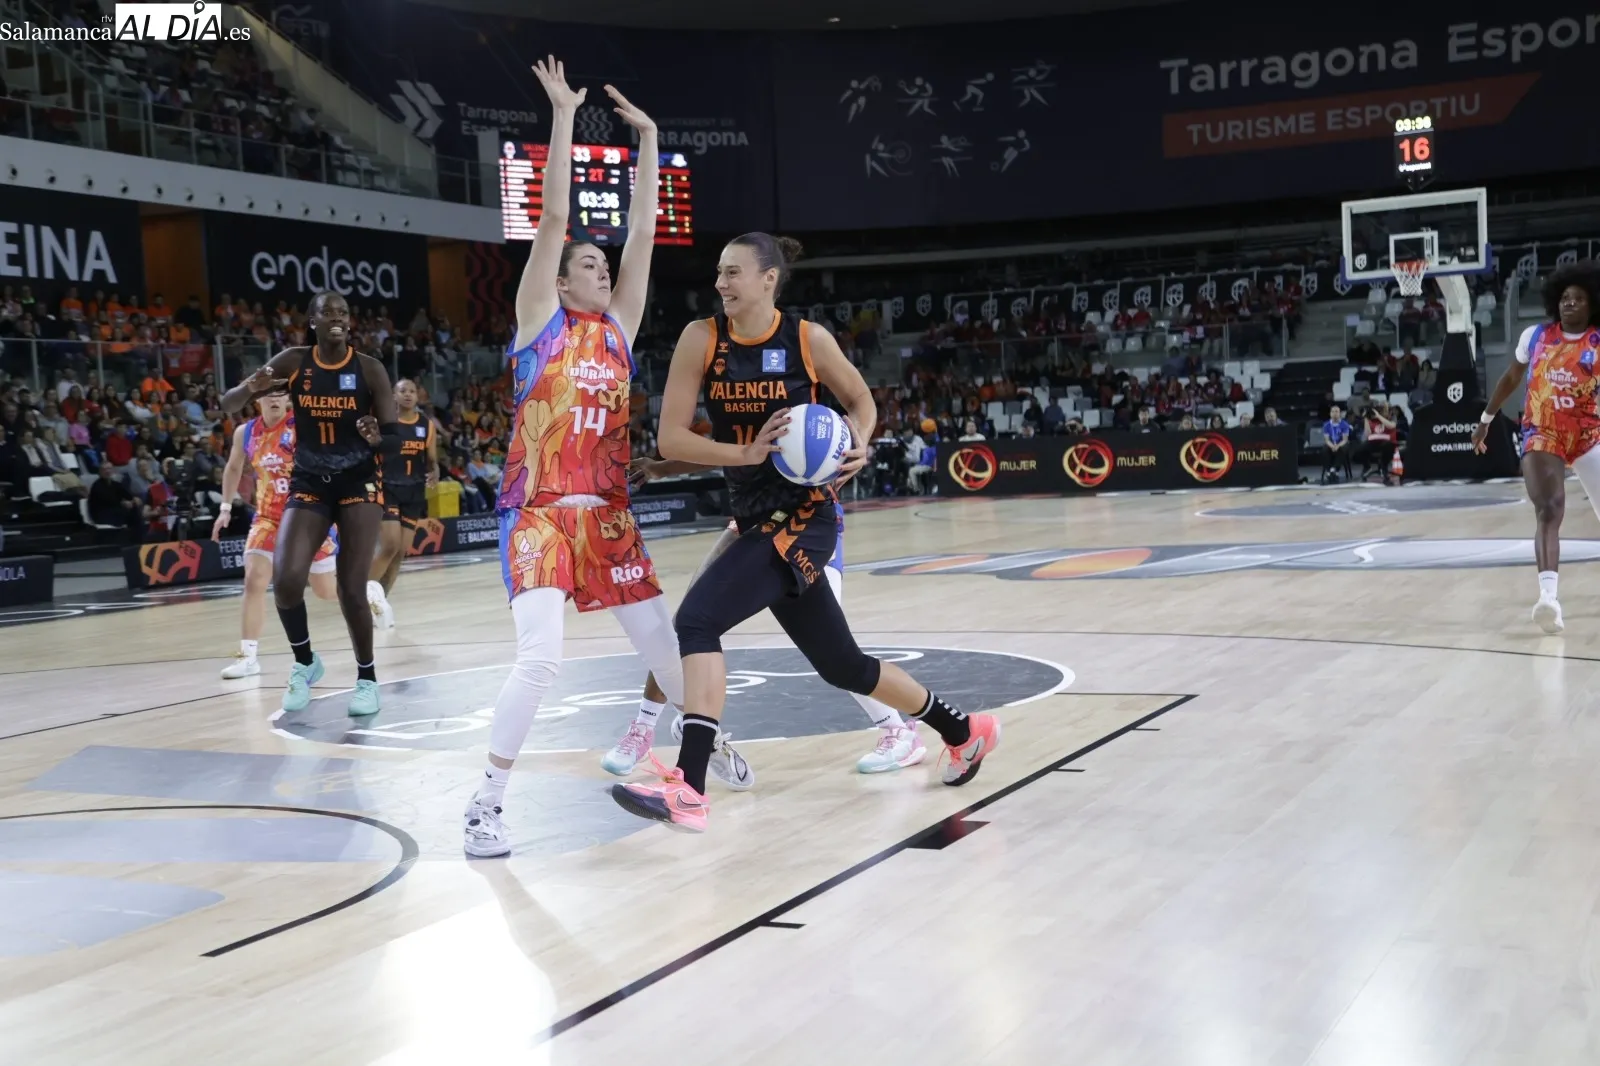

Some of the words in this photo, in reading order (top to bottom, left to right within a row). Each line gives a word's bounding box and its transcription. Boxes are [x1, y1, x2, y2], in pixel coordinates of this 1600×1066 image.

[1160, 39, 1418, 95] Tarragona
[457, 102, 538, 124] Tarragona
[1187, 112, 1316, 146] TURISME
[1326, 93, 1482, 132] ESPORTIU
[572, 146, 591, 162] 33
[603, 148, 621, 164] 29
[1399, 136, 1431, 162] 16
[578, 191, 620, 209] 03:36
[579, 210, 589, 226] 1
[610, 211, 621, 227] 5
[0, 221, 118, 284] EINA
[251, 245, 399, 299] endesa
[710, 380, 788, 400] VALENCIA
[298, 394, 357, 411] VALENCIA
[724, 402, 766, 413] BASKET
[1549, 395, 1575, 410] 10
[310, 409, 342, 418] BASKET
[569, 406, 607, 437] 14
[318, 421, 336, 444] 11
[1237, 449, 1279, 462] MUJER
[1431, 443, 1453, 453] COPA
[405, 460, 412, 476] 1
[1000, 459, 1037, 471] MUJER
[1117, 455, 1156, 467] MUJER
[457, 517, 496, 531] FEDERACIÓN
[458, 533, 468, 544] DE
[221, 556, 234, 568] DE
[611, 563, 644, 584] Río
